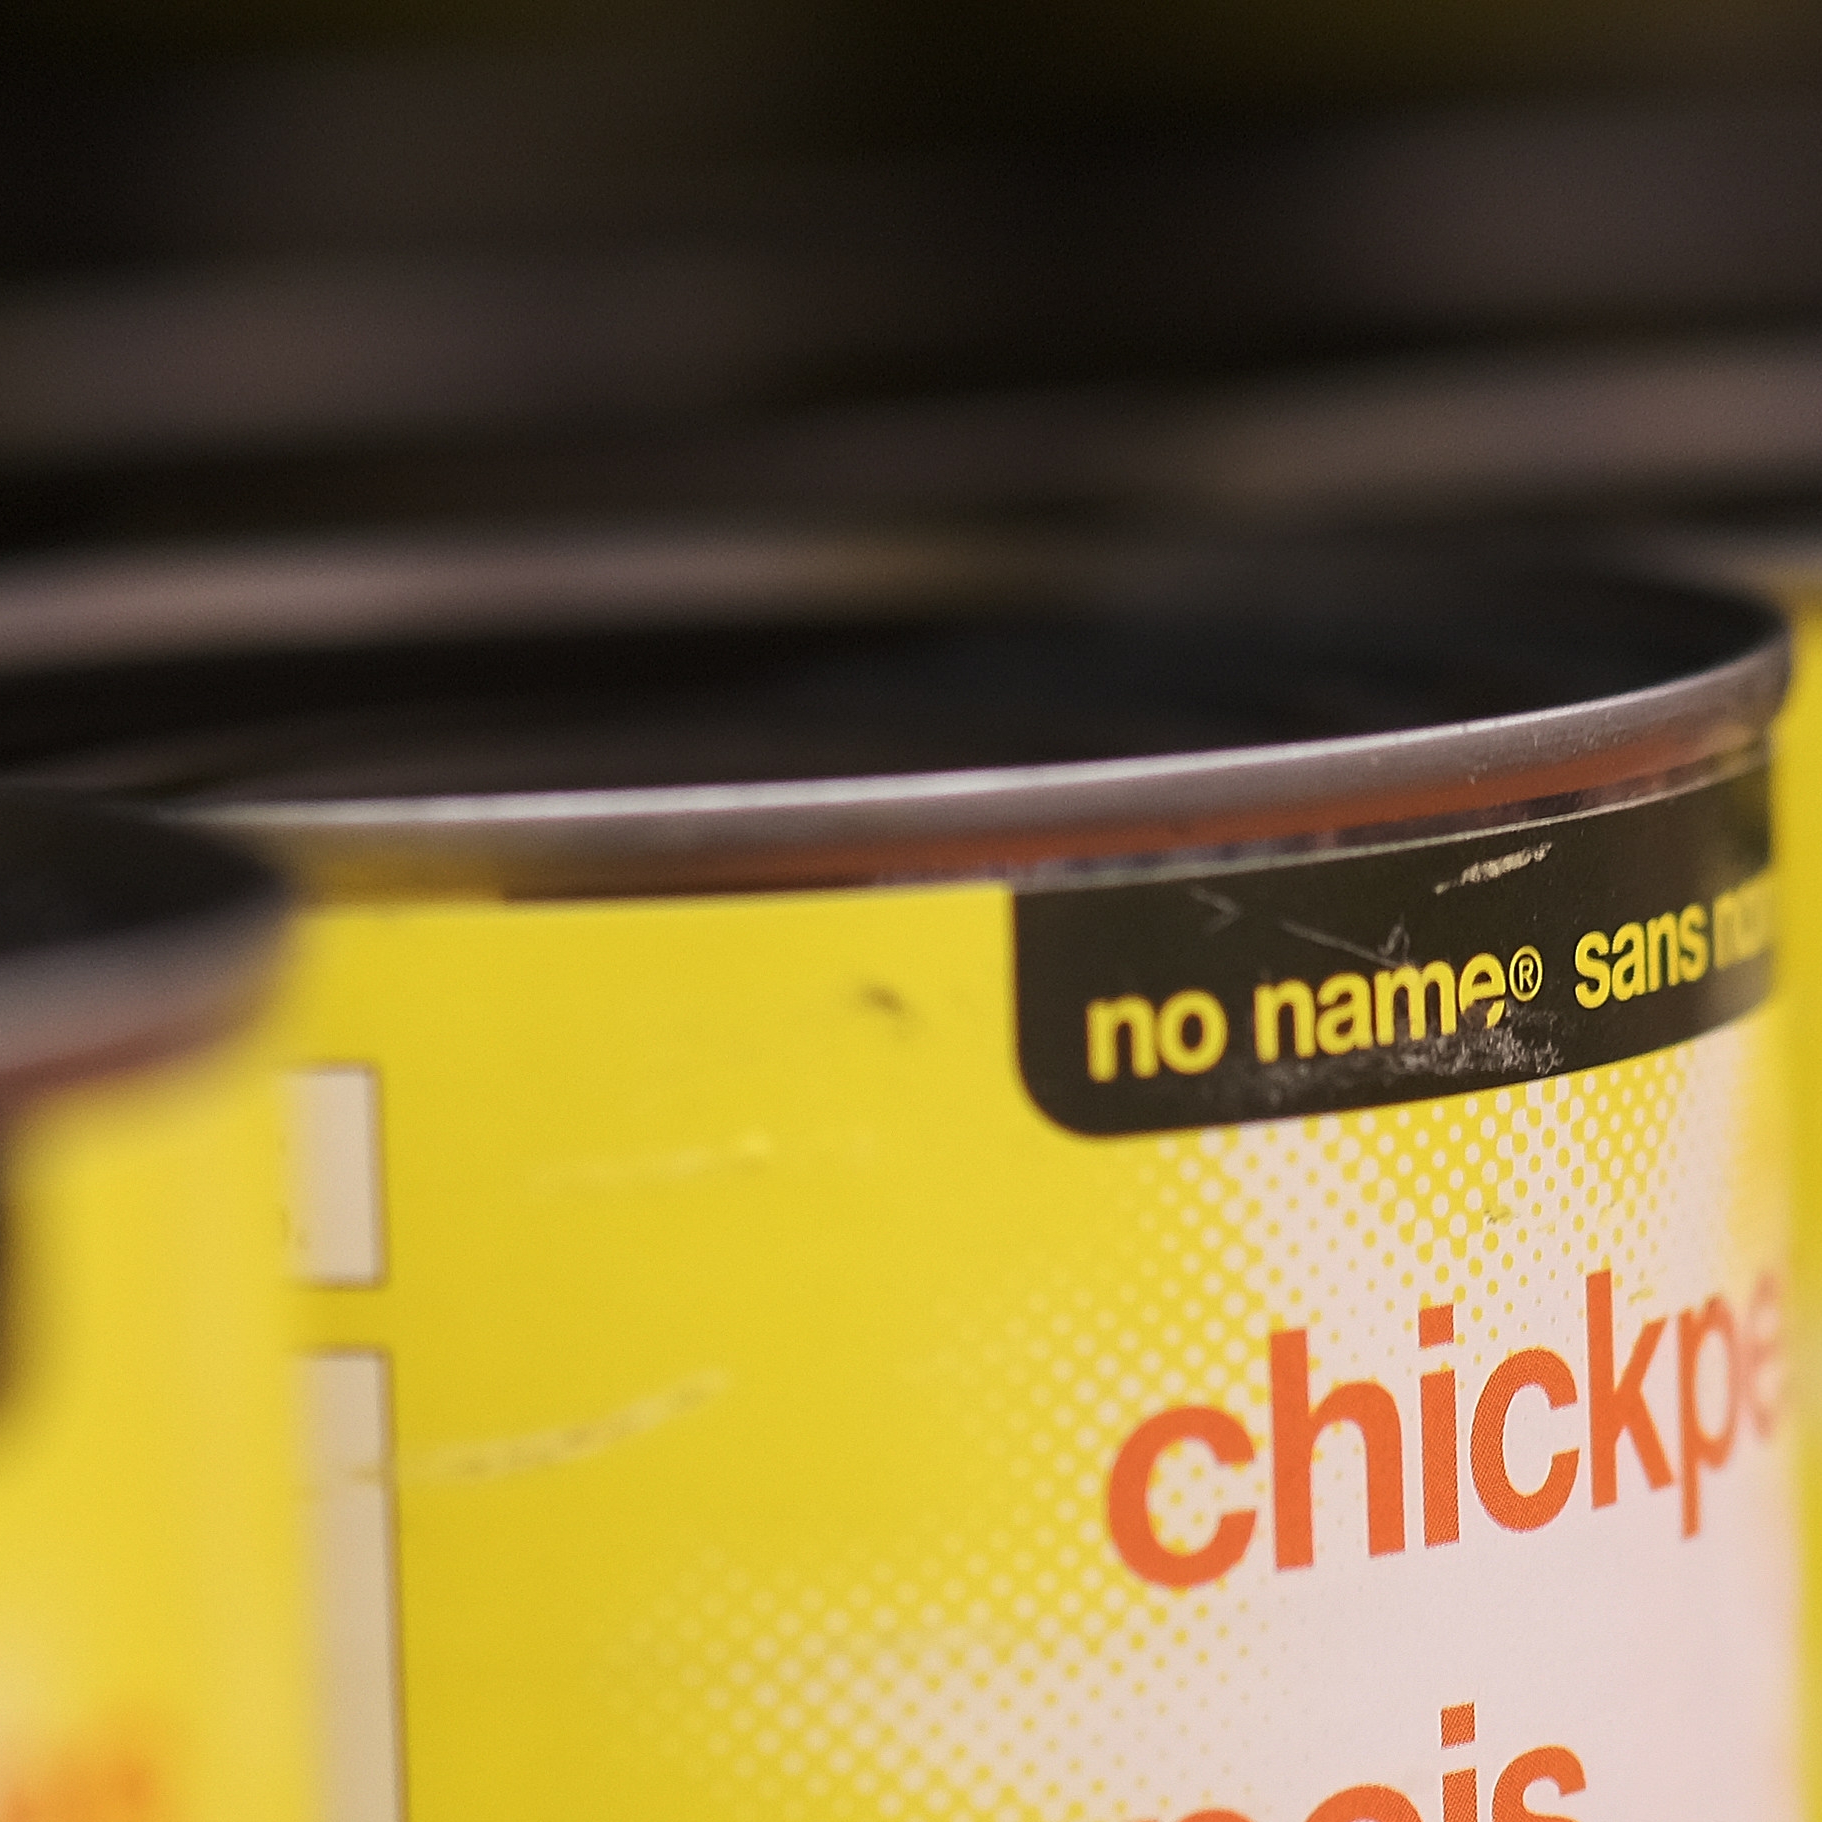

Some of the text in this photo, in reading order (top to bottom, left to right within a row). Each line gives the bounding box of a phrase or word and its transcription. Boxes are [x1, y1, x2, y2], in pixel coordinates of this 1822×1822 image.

[1087, 990, 1227, 1083] no
[1574, 902, 1711, 1009] sans
[1107, 1267, 1785, 1590] chickpe
